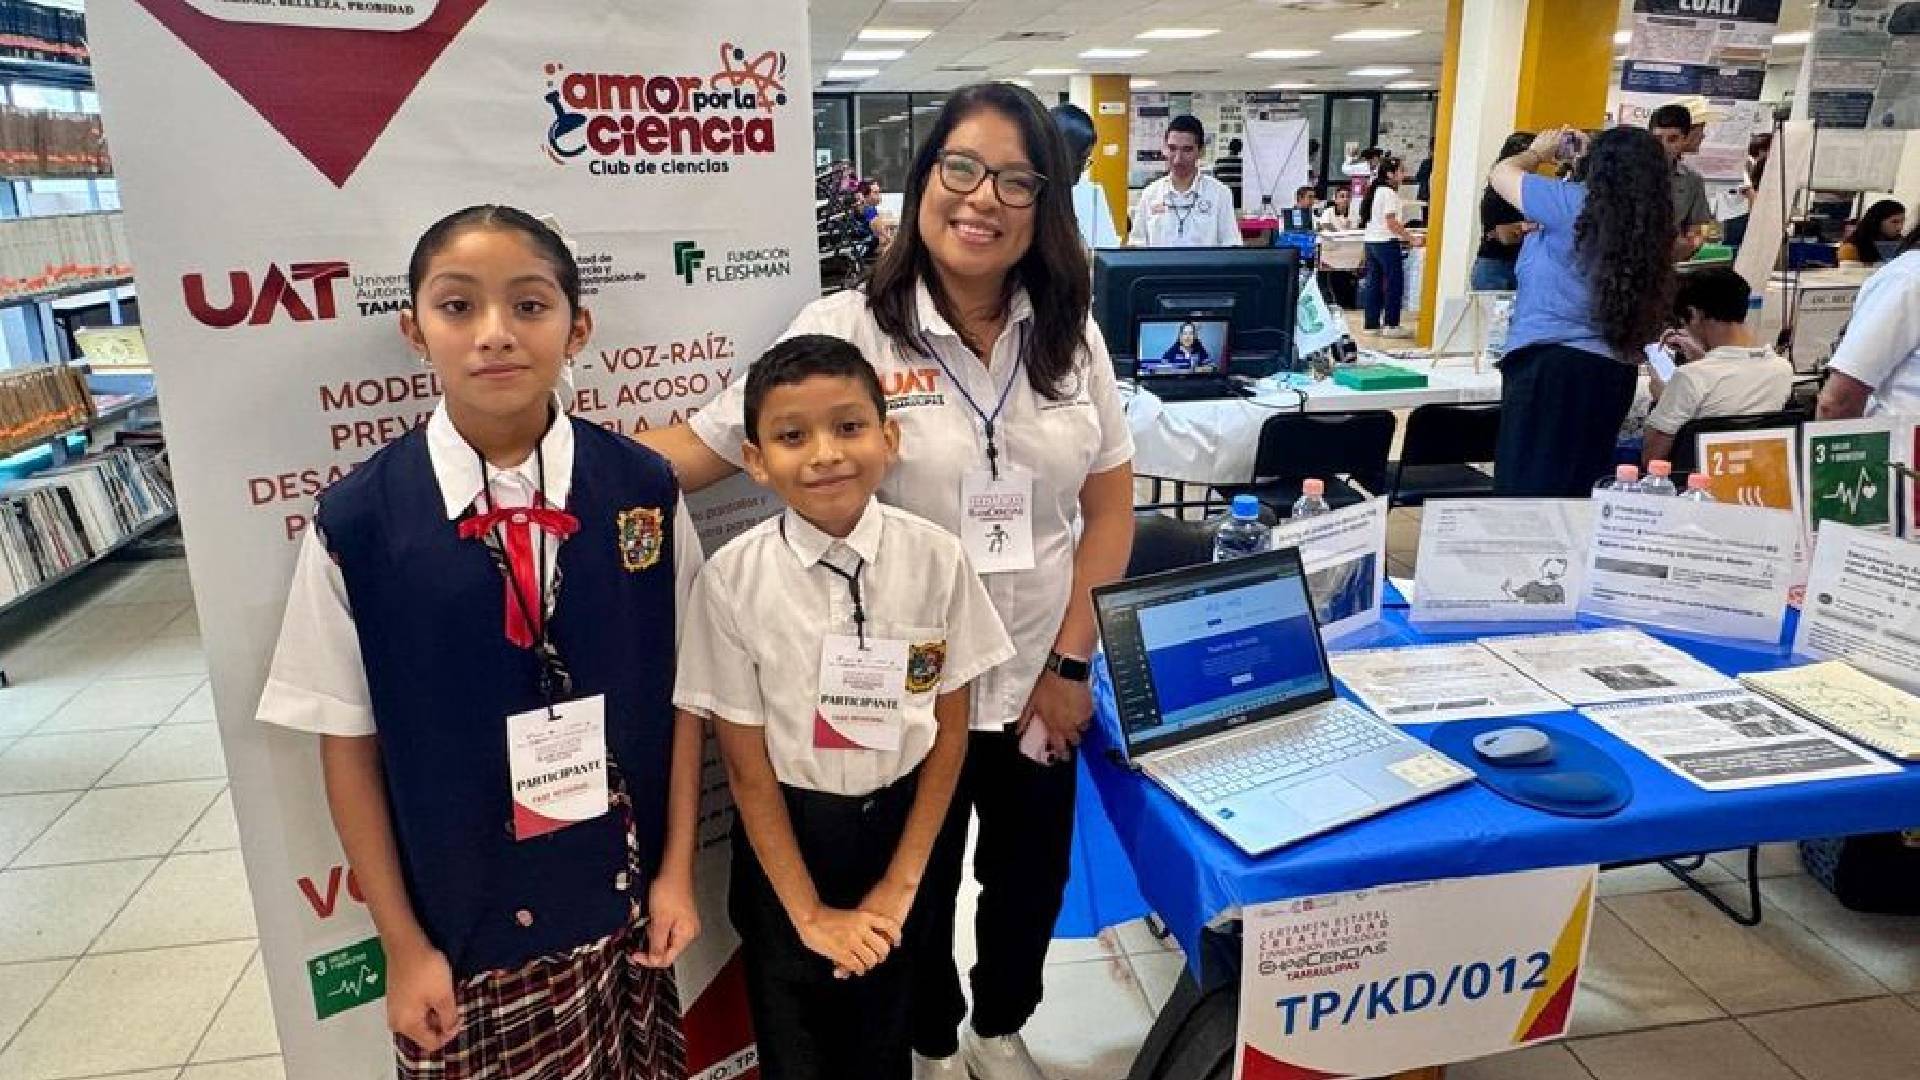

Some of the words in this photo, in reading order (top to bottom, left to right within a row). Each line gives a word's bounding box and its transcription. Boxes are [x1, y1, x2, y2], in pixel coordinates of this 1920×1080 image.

[348, 2, 415, 15] PROBIDAD
[562, 73, 702, 114] amor
[586, 115, 776, 156] ciencia
[589, 159, 630, 175] Club
[634, 158, 657, 174] de
[661, 158, 730, 174] ciencias
[353, 273, 409, 287] Univer
[706, 262, 790, 282] FLEISHMAN
[182, 261, 350, 329] UAT
[357, 299, 412, 317] TAMA
[319, 372, 443, 412] MODEL
[601, 330, 734, 373] VOZ-RAÍZ:
[879, 367, 941, 396] UAT
[616, 372, 708, 407] ACOSO
[716, 367, 732, 390] Y
[1713, 452, 1724, 476] 2
[1815, 444, 1827, 464] 3
[248, 464, 364, 506] DESA
[820, 694, 898, 710] PARTICIPANTE
[516, 760, 601, 791] PARTICIPANTE
[1260, 919, 1389, 950] CREATIVIDAD
[315, 959, 327, 977] 3
[1276, 951, 1551, 1036] TP/KD/012
